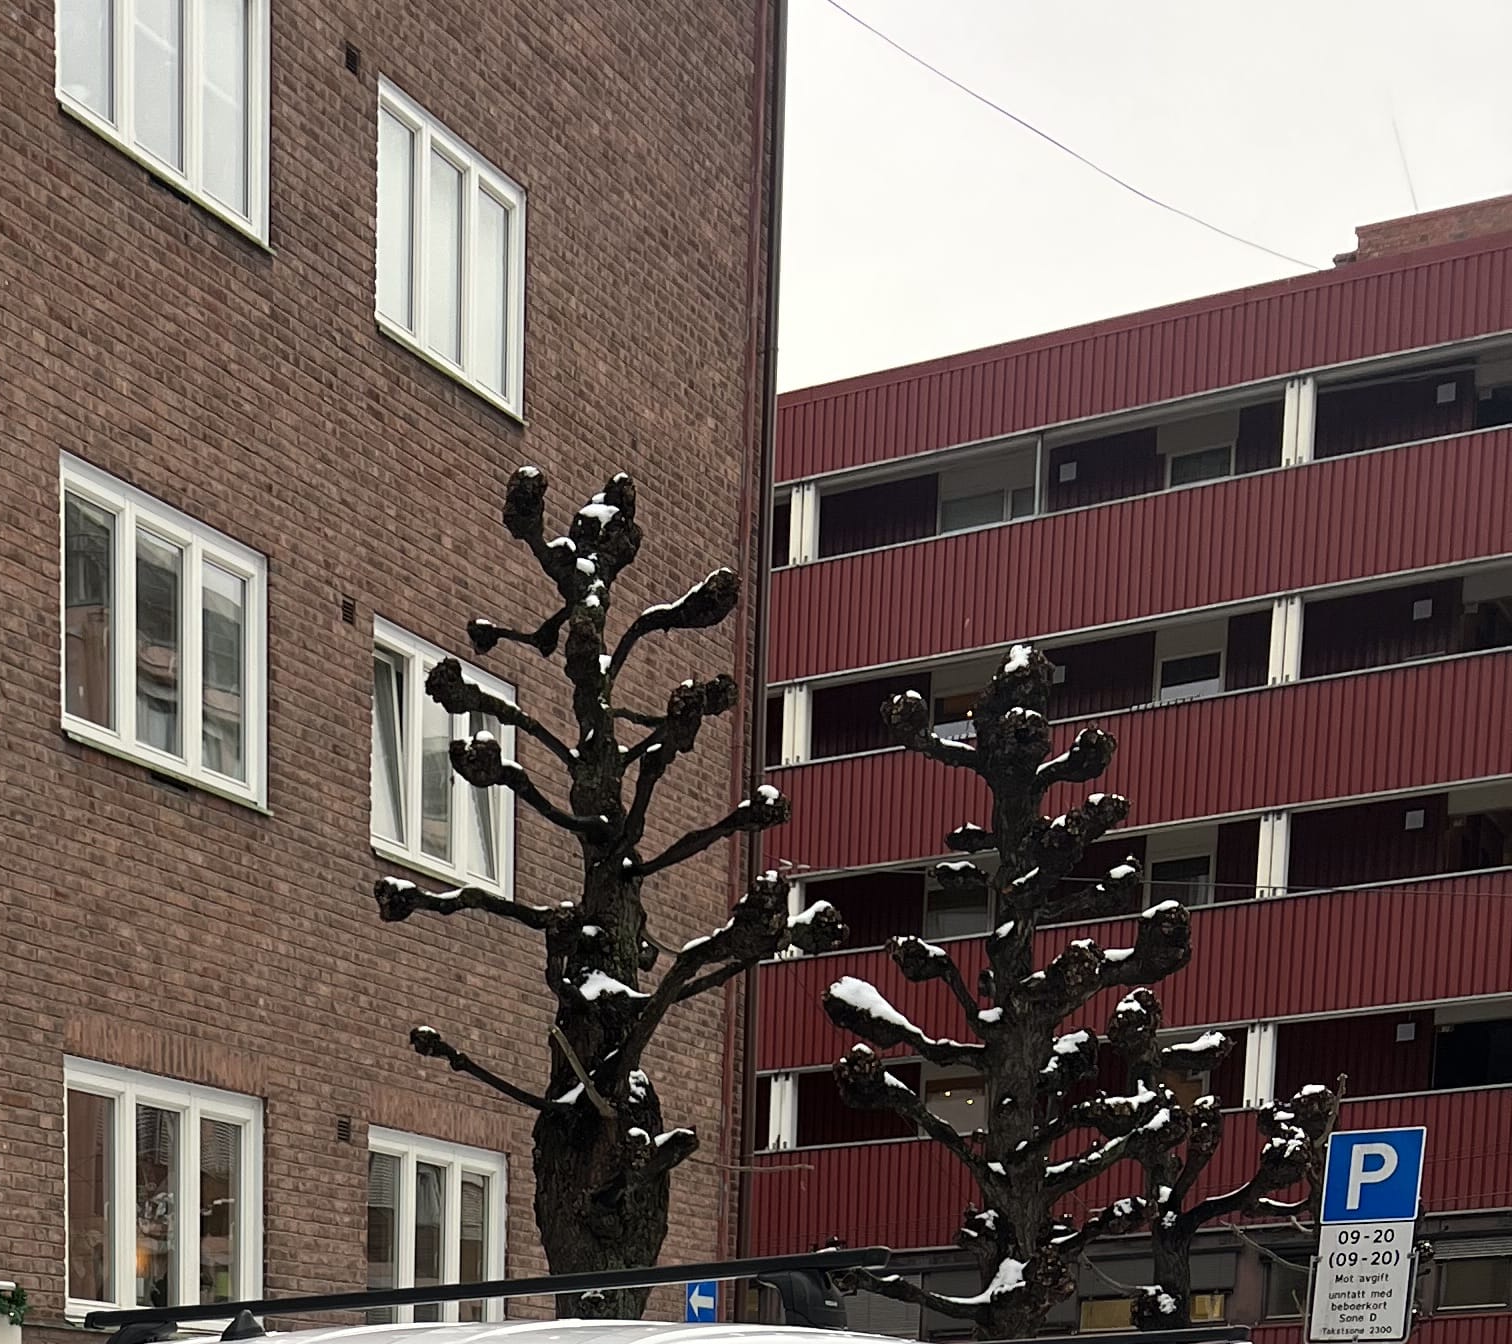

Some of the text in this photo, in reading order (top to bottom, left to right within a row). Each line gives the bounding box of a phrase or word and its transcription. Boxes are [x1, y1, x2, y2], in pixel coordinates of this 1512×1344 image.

[1346, 1143, 1398, 1210] P
[1328, 1250, 1400, 1268] (09-20)
[1335, 1273, 1389, 1284] Mot avgift
[1328, 1289, 1392, 1300] unntatt med
[1331, 1301, 1387, 1311] beboerkort
[1339, 1313, 1377, 1323] Sone D
[1369, 1325, 1392, 1335] 2300
